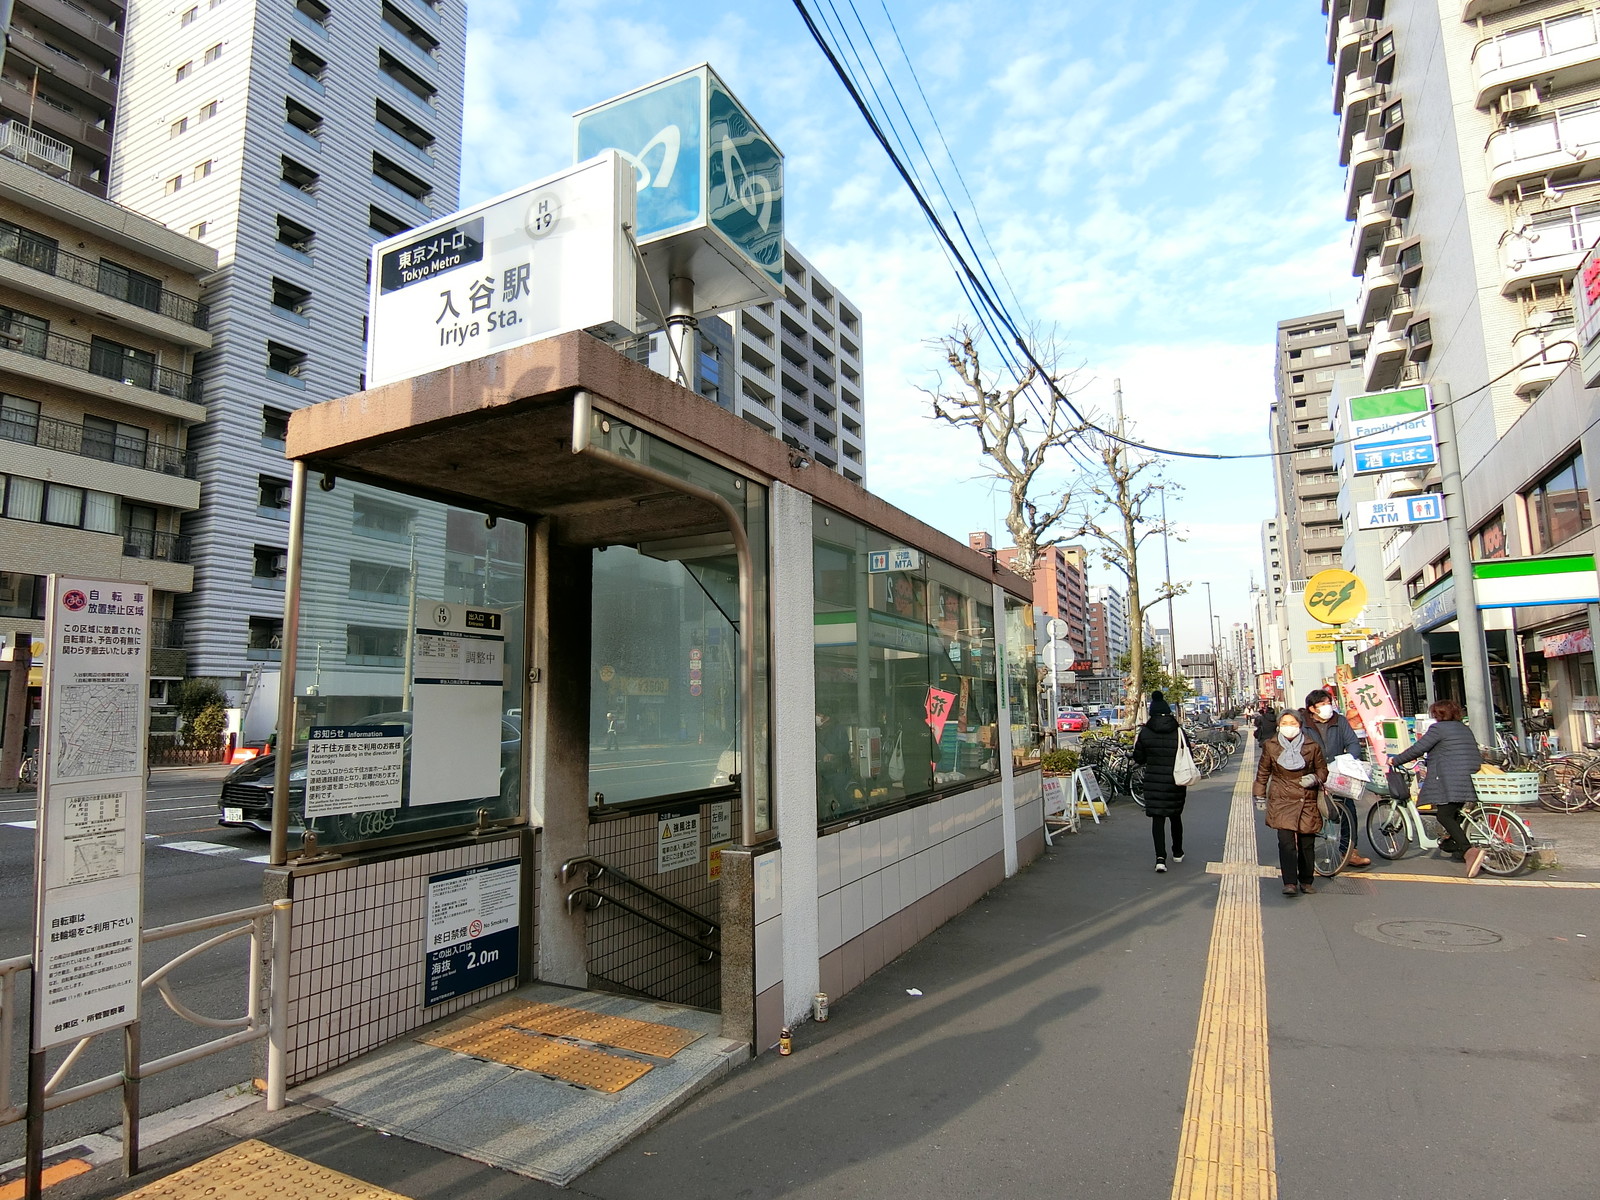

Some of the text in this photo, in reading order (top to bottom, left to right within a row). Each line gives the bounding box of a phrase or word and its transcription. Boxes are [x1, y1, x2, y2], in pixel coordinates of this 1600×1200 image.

[538, 200, 549, 214] H
[536, 213, 553, 231] 19
[398, 231, 465, 270] 東京メトロ
[402, 254, 460, 282] Tokyo Metro
[435, 263, 530, 325] 入谷駅
[440, 309, 523, 347] Iriya Sta.
[1356, 419, 1427, 436] FamilyMart
[1365, 448, 1428, 468] 酒 たばこ
[1372, 502, 1395, 513] 銀行
[1370, 512, 1399, 525] ATM
[90, 590, 144, 603] 自転車
[88, 603, 144, 616] 放置禁止区域
[468, 613, 485, 621] 出入口
[438, 615, 448, 623] 19
[489, 615, 496, 628] 1
[63, 624, 142, 635] この区域に放置された
[466, 650, 496, 665] 調整中
[1355, 683, 1383, 710] 花
[313, 729, 345, 738] お知らせ
[311, 742, 401, 753] 北千住方面をご利用のお客様
[309, 792, 335, 800] 便利です。
[51, 913, 86, 929] 自転車は
[491, 918, 509, 926] Smoking
[51, 917, 134, 943] 駐輪場をご利用下さい
[434, 926, 468, 945] 終日禁煙
[432, 942, 473, 961] この出入口は
[431, 959, 451, 975] 海抜
[467, 949, 499, 970] 2.0m
